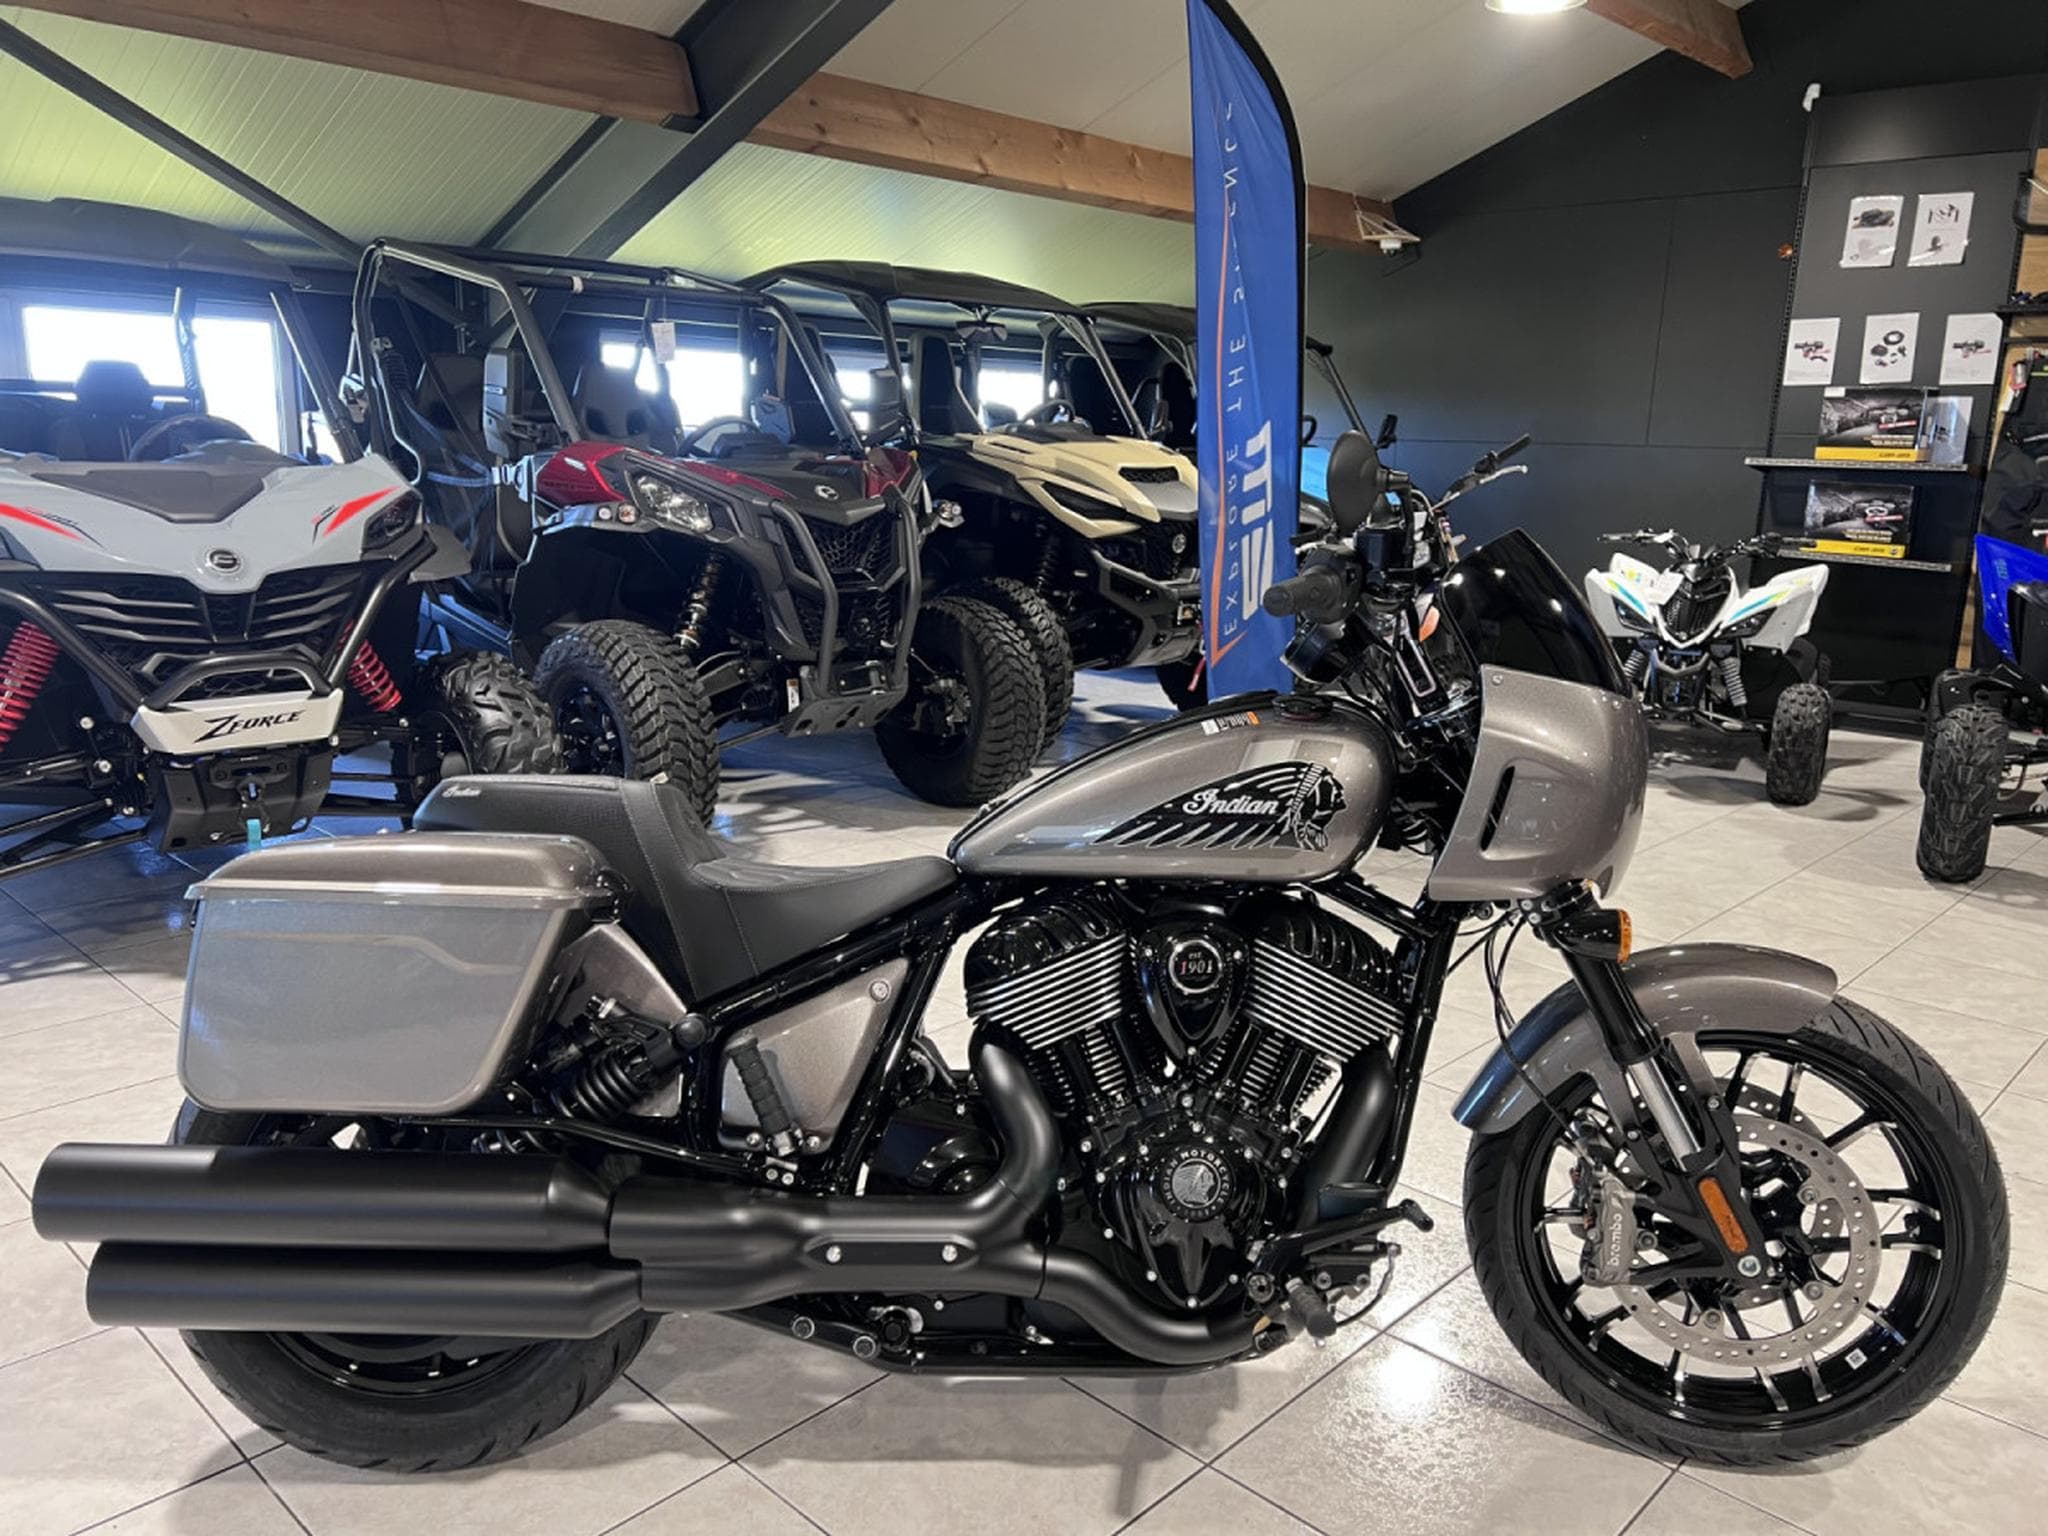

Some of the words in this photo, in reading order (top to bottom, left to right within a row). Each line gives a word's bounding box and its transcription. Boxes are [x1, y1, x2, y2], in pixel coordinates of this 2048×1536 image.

[1182, 788, 1279, 815] Indian
[1163, 1159, 1179, 1205] INDIAN
[1180, 1148, 1230, 1204] MOTORCYCLE
[1606, 1213, 1623, 1267] brembo
